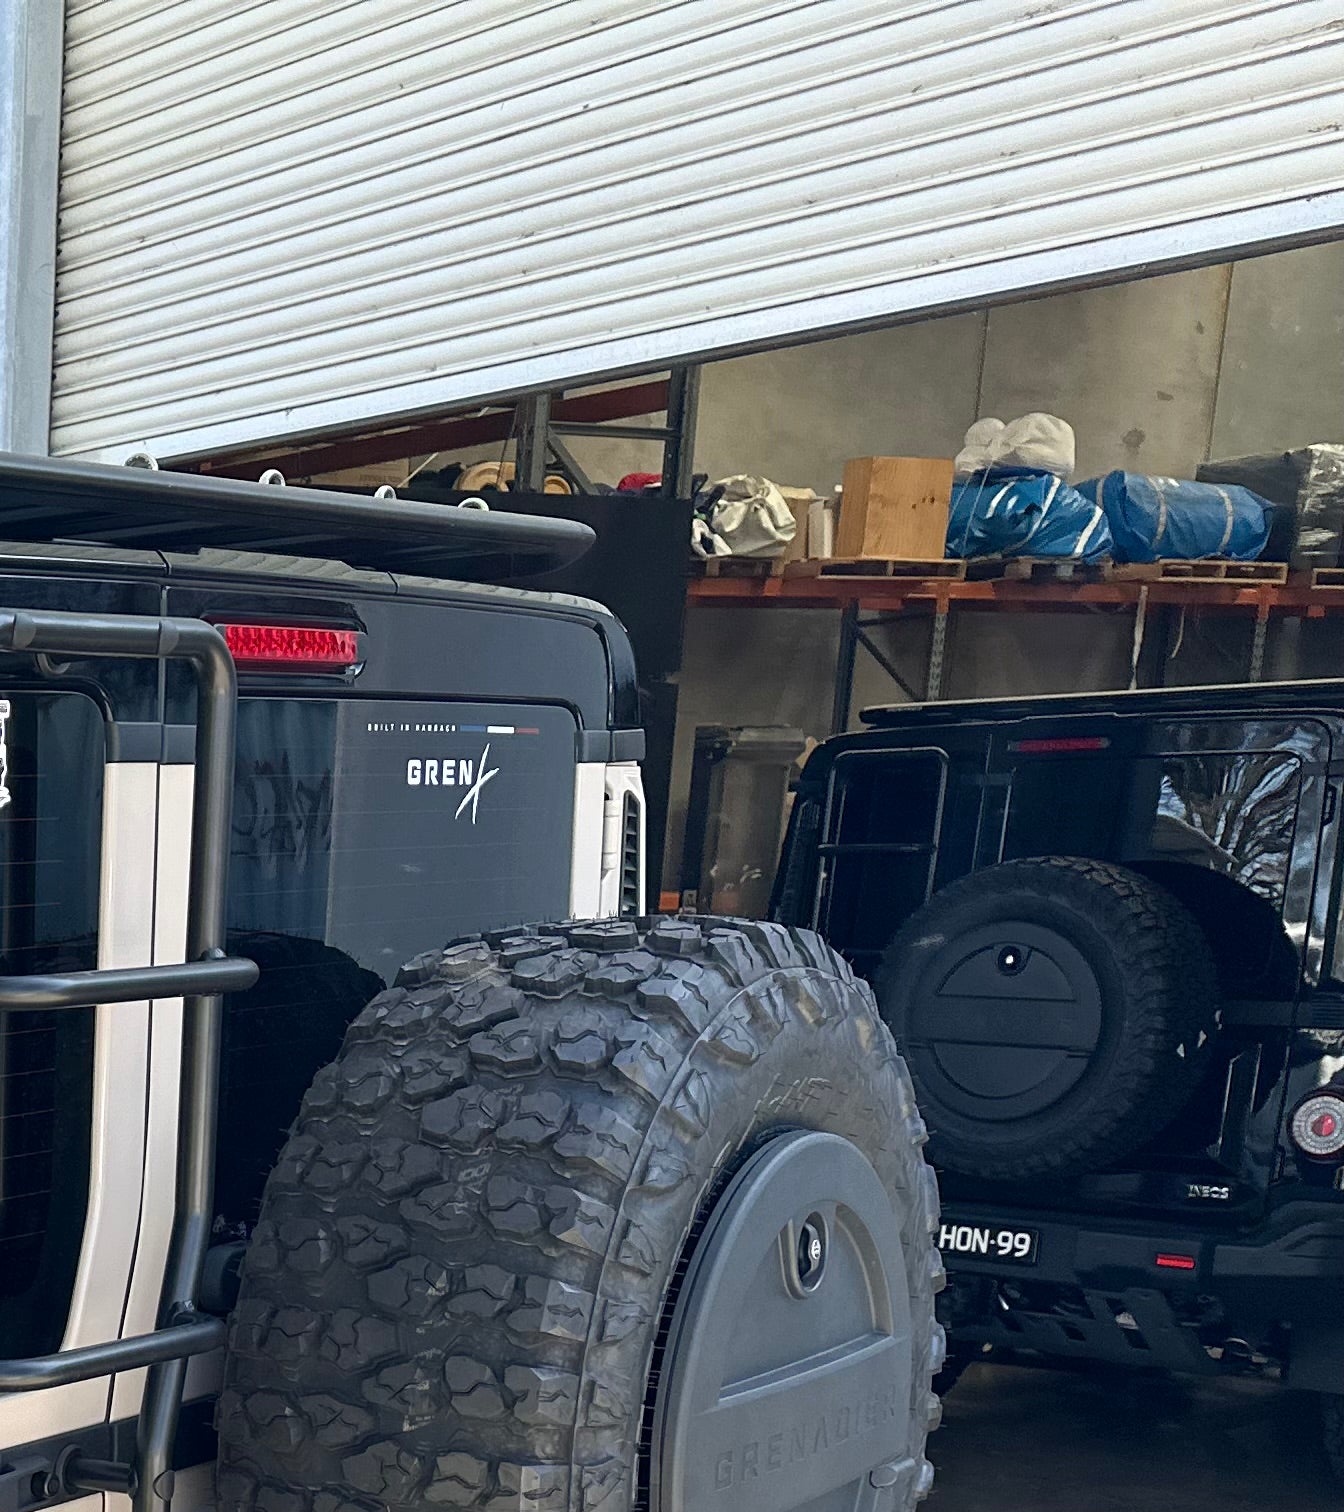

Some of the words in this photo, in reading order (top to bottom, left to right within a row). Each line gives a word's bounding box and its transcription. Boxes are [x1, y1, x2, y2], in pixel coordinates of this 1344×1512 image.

[367, 723, 395, 732] BUILT
[400, 723, 410, 732] IN
[1188, 1184, 1230, 1199] INEOS
[714, 1384, 897, 1493] GRENADIER
